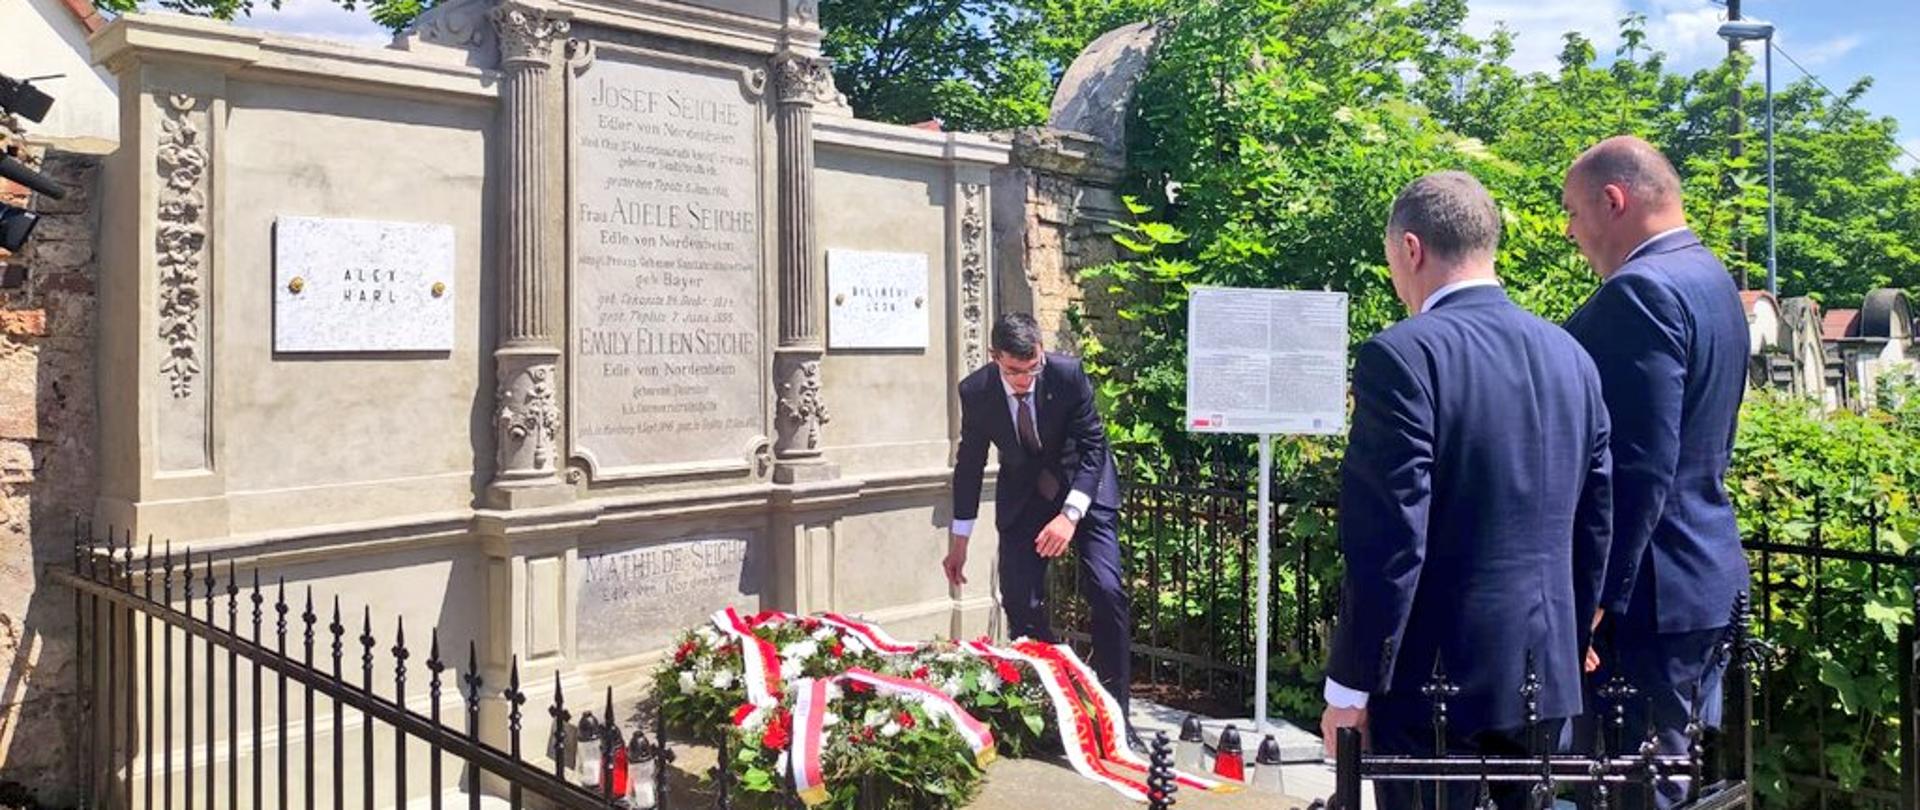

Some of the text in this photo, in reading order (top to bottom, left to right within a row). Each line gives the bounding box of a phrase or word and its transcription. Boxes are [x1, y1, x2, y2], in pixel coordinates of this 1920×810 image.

[591, 77, 740, 126] JOSEF SEICHE
[579, 197, 754, 233] Frau ADELE SEICHE
[600, 230, 629, 245] Edle
[634, 235, 656, 247] von
[344, 268, 395, 283] ALEX
[663, 272, 703, 291] Bayer
[579, 328, 754, 355] EMILY ELLEN SEICHE
[603, 363, 630, 378] Edle
[637, 365, 659, 377] von
[585, 550, 682, 583] MATHILDE
